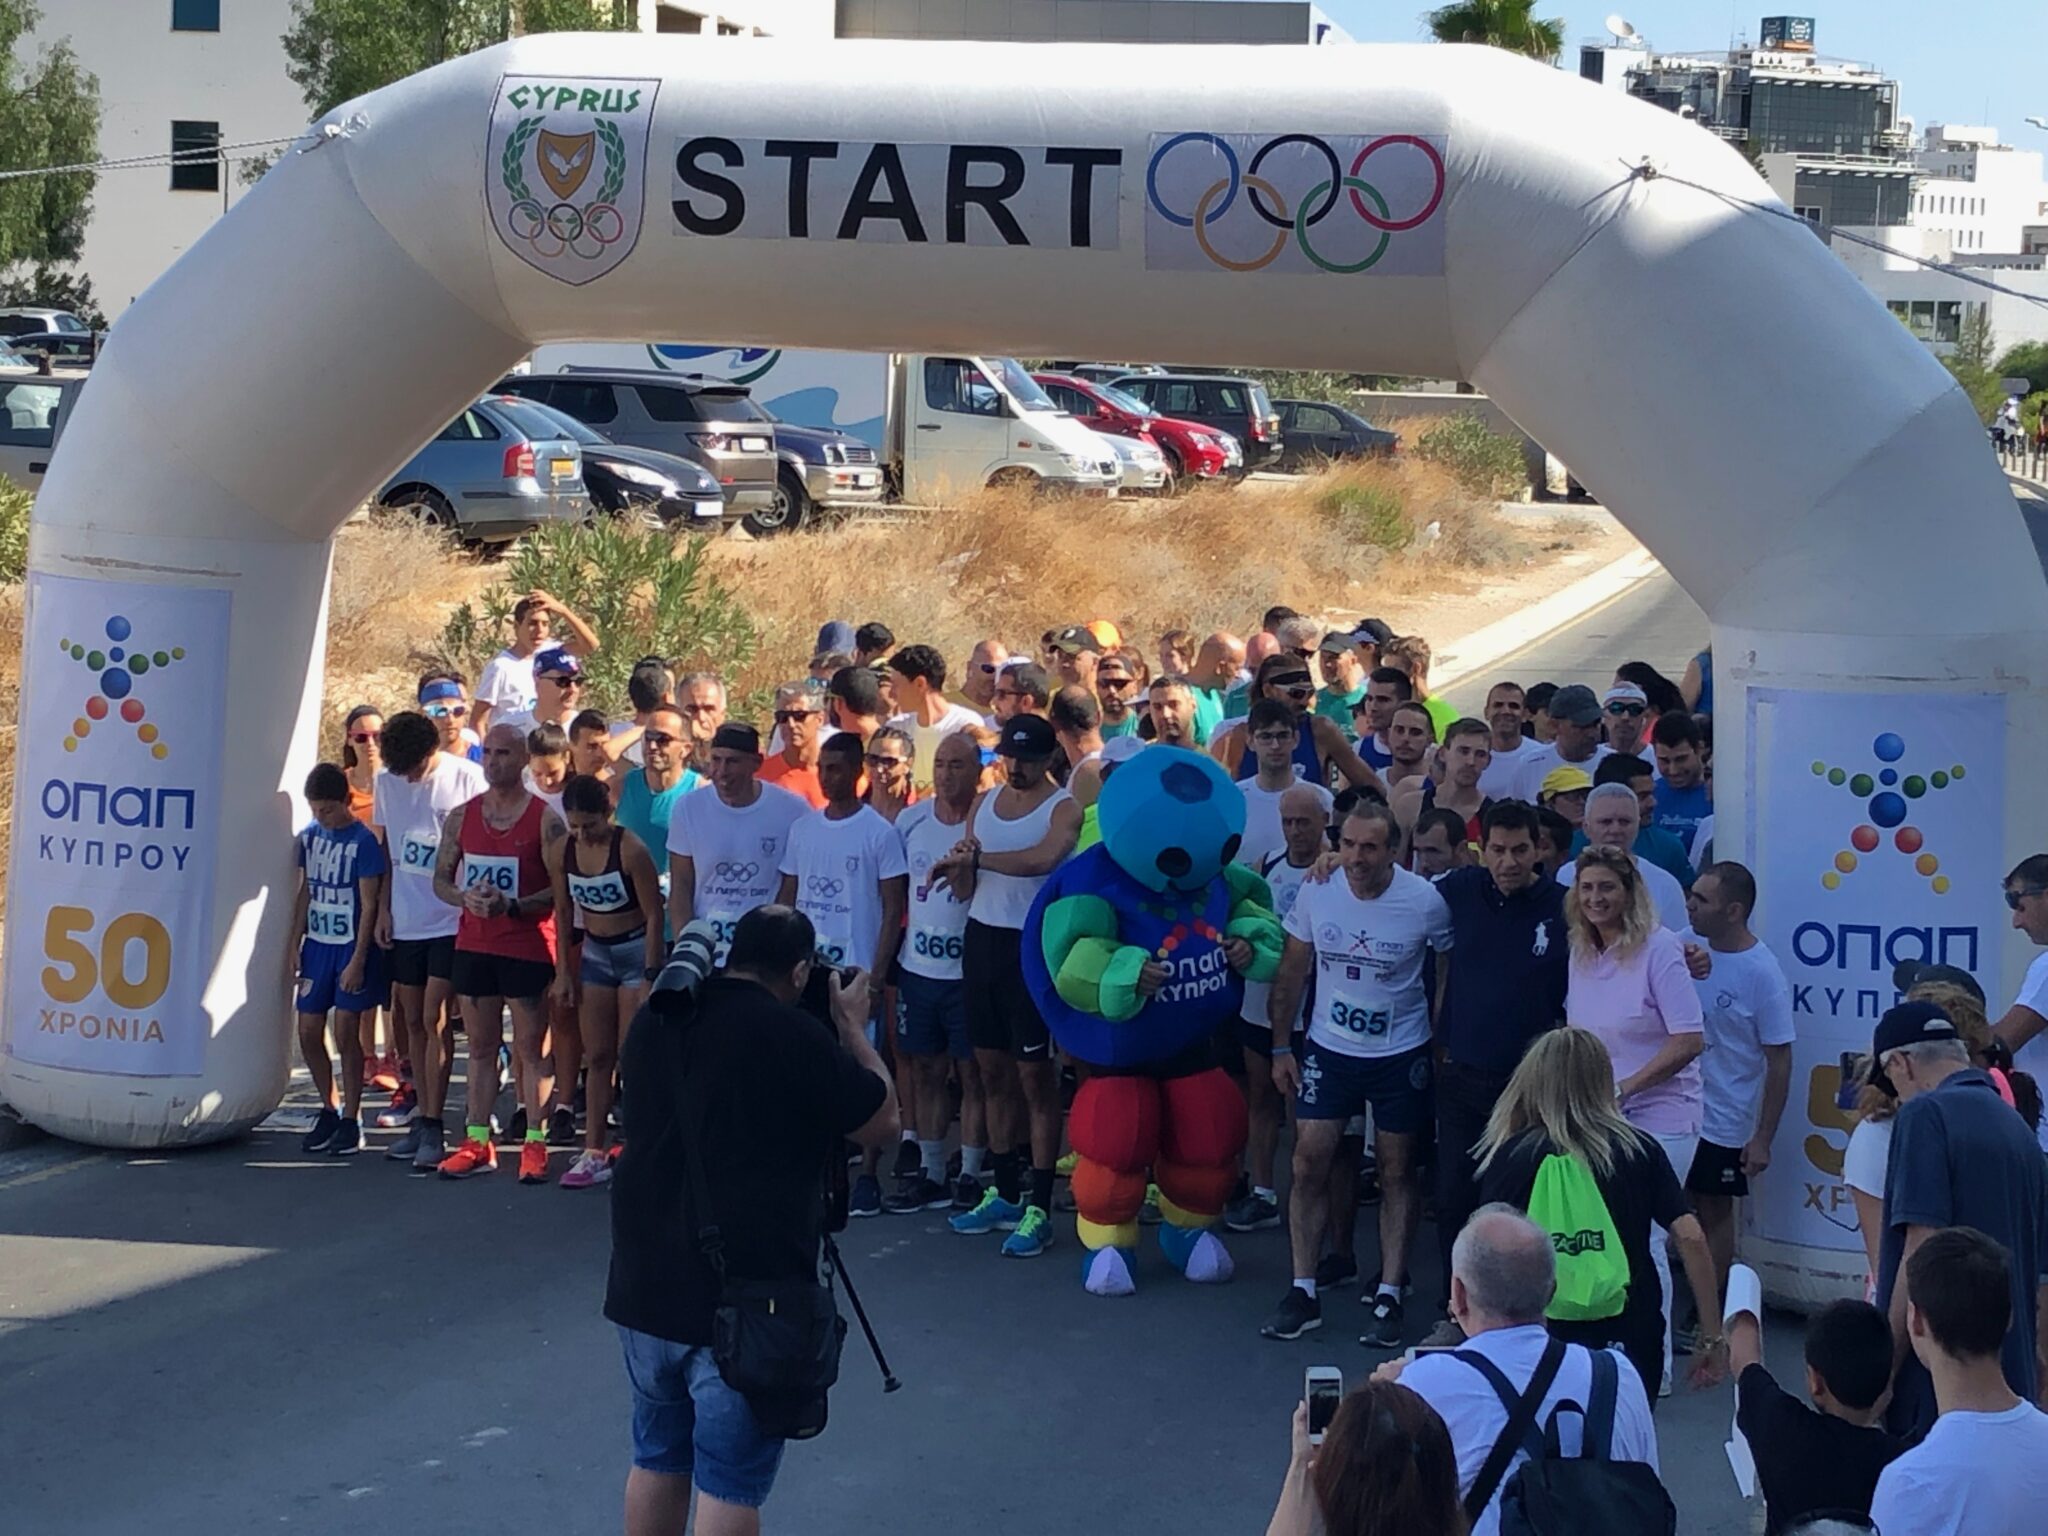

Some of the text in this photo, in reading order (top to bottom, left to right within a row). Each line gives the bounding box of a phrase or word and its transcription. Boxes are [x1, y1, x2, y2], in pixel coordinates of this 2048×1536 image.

[507, 85, 641, 113] CYPRUS
[672, 136, 1122, 247] START
[40, 834, 190, 871] ΚΥΠΡΟΥ
[302, 834, 359, 885] WHAT
[467, 865, 513, 891] 246
[573, 883, 621, 905] 333
[310, 909, 349, 936] 315
[41, 905, 172, 1010] 50
[915, 931, 962, 959] 366
[1154, 969, 1228, 1002] ΚΥΠΡΟΥ
[40, 1009, 165, 1043] ΧΡΟΝΙΑ
[1331, 1001, 1387, 1035] 365
